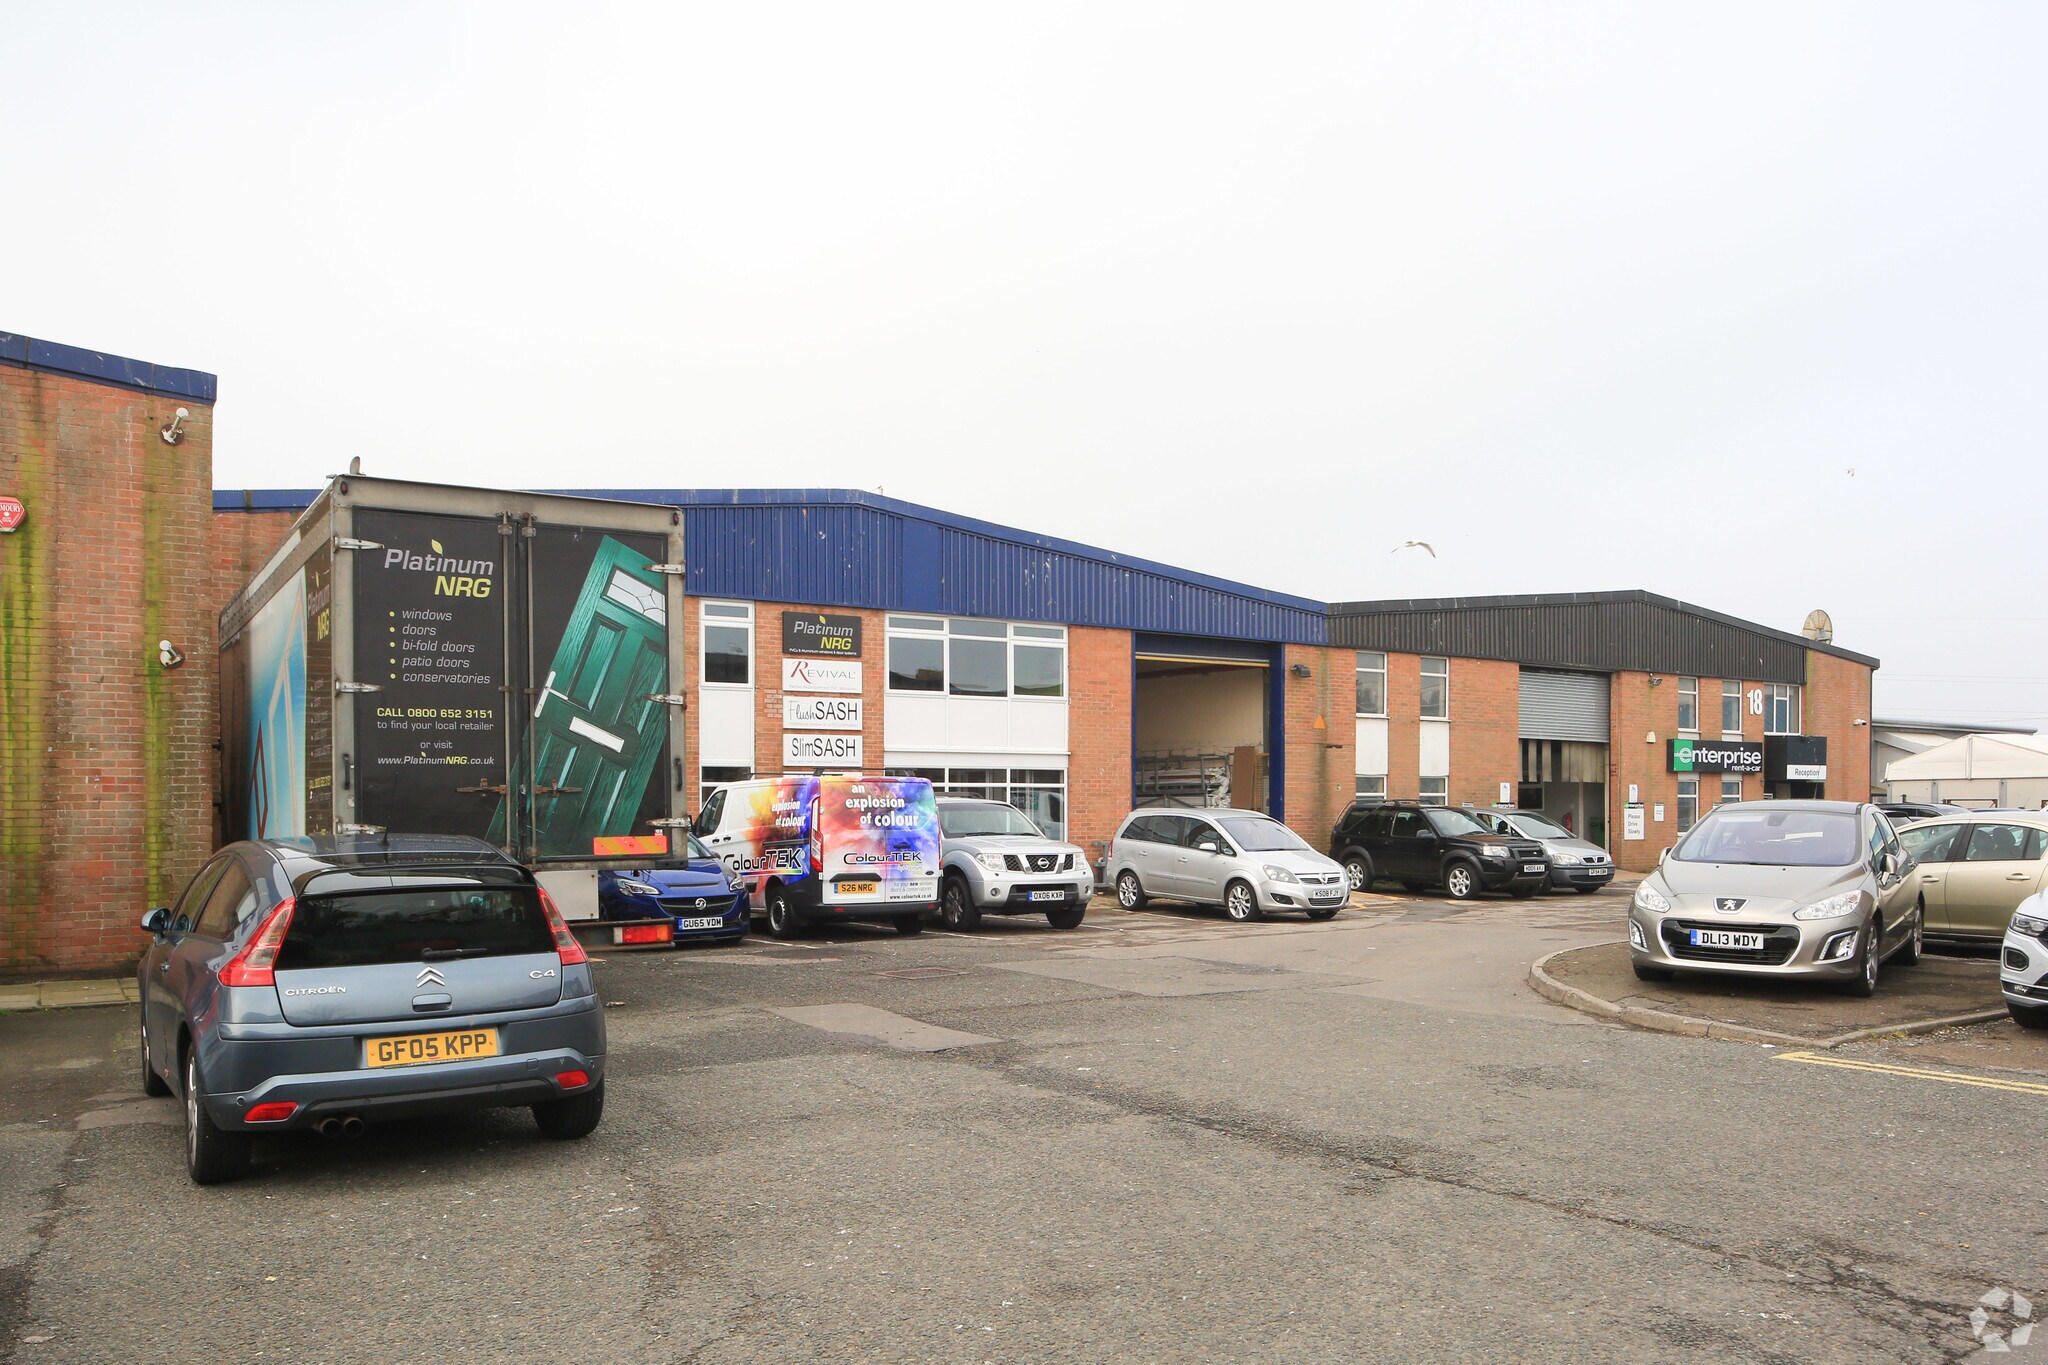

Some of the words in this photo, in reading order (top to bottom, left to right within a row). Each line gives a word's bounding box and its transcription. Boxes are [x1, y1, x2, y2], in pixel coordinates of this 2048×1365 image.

[384, 548, 494, 576] Platinum
[434, 575, 492, 598] NRG
[402, 608, 453, 621] windows
[317, 608, 330, 642] NRG
[402, 624, 437, 636] doors
[793, 620, 854, 637] Platinum
[402, 639, 438, 651] bi-fold
[441, 641, 475, 653] doors
[820, 636, 852, 650] NRG
[402, 655, 432, 668] patio
[436, 656, 470, 668] doors
[402, 672, 491, 684] conservatories
[1745, 688, 1763, 715] 18
[376, 707, 405, 717] CALL
[407, 708, 437, 718] 0800
[440, 709, 462, 718] 652
[465, 709, 493, 719] 3151
[377, 721, 387, 729] to
[391, 720, 408, 729] find
[411, 722, 432, 731] your
[435, 721, 457, 730] local
[460, 721, 494, 731] retailer
[420, 741, 430, 749] or
[433, 740, 453, 749] visit
[791, 737, 856, 757] SlimSASH
[377, 755, 495, 765] www.PlatinumNRG.co.uk
[1678, 746, 1762, 769] enterprise
[1731, 764, 1762, 772] rent-a-car
[1794, 768, 1820, 777] Reception
[851, 784, 866, 794] an
[771, 798, 801, 814] explosion
[845, 794, 905, 811] explosion
[781, 812, 806, 828] colour
[860, 811, 872, 824] of
[874, 810, 919, 827] colour
[843, 852, 922, 865] ColourTEK
[841, 883, 856, 892] S26
[857, 883, 873, 892] NRG
[683, 919, 704, 928] GU65
[706, 918, 722, 927] VDM
[1702, 932, 1730, 945] DL13
[1734, 934, 1758, 946] WDY
[528, 969, 556, 979] C4
[378, 1037, 439, 1062] GF05
[445, 1033, 487, 1056] KPP
